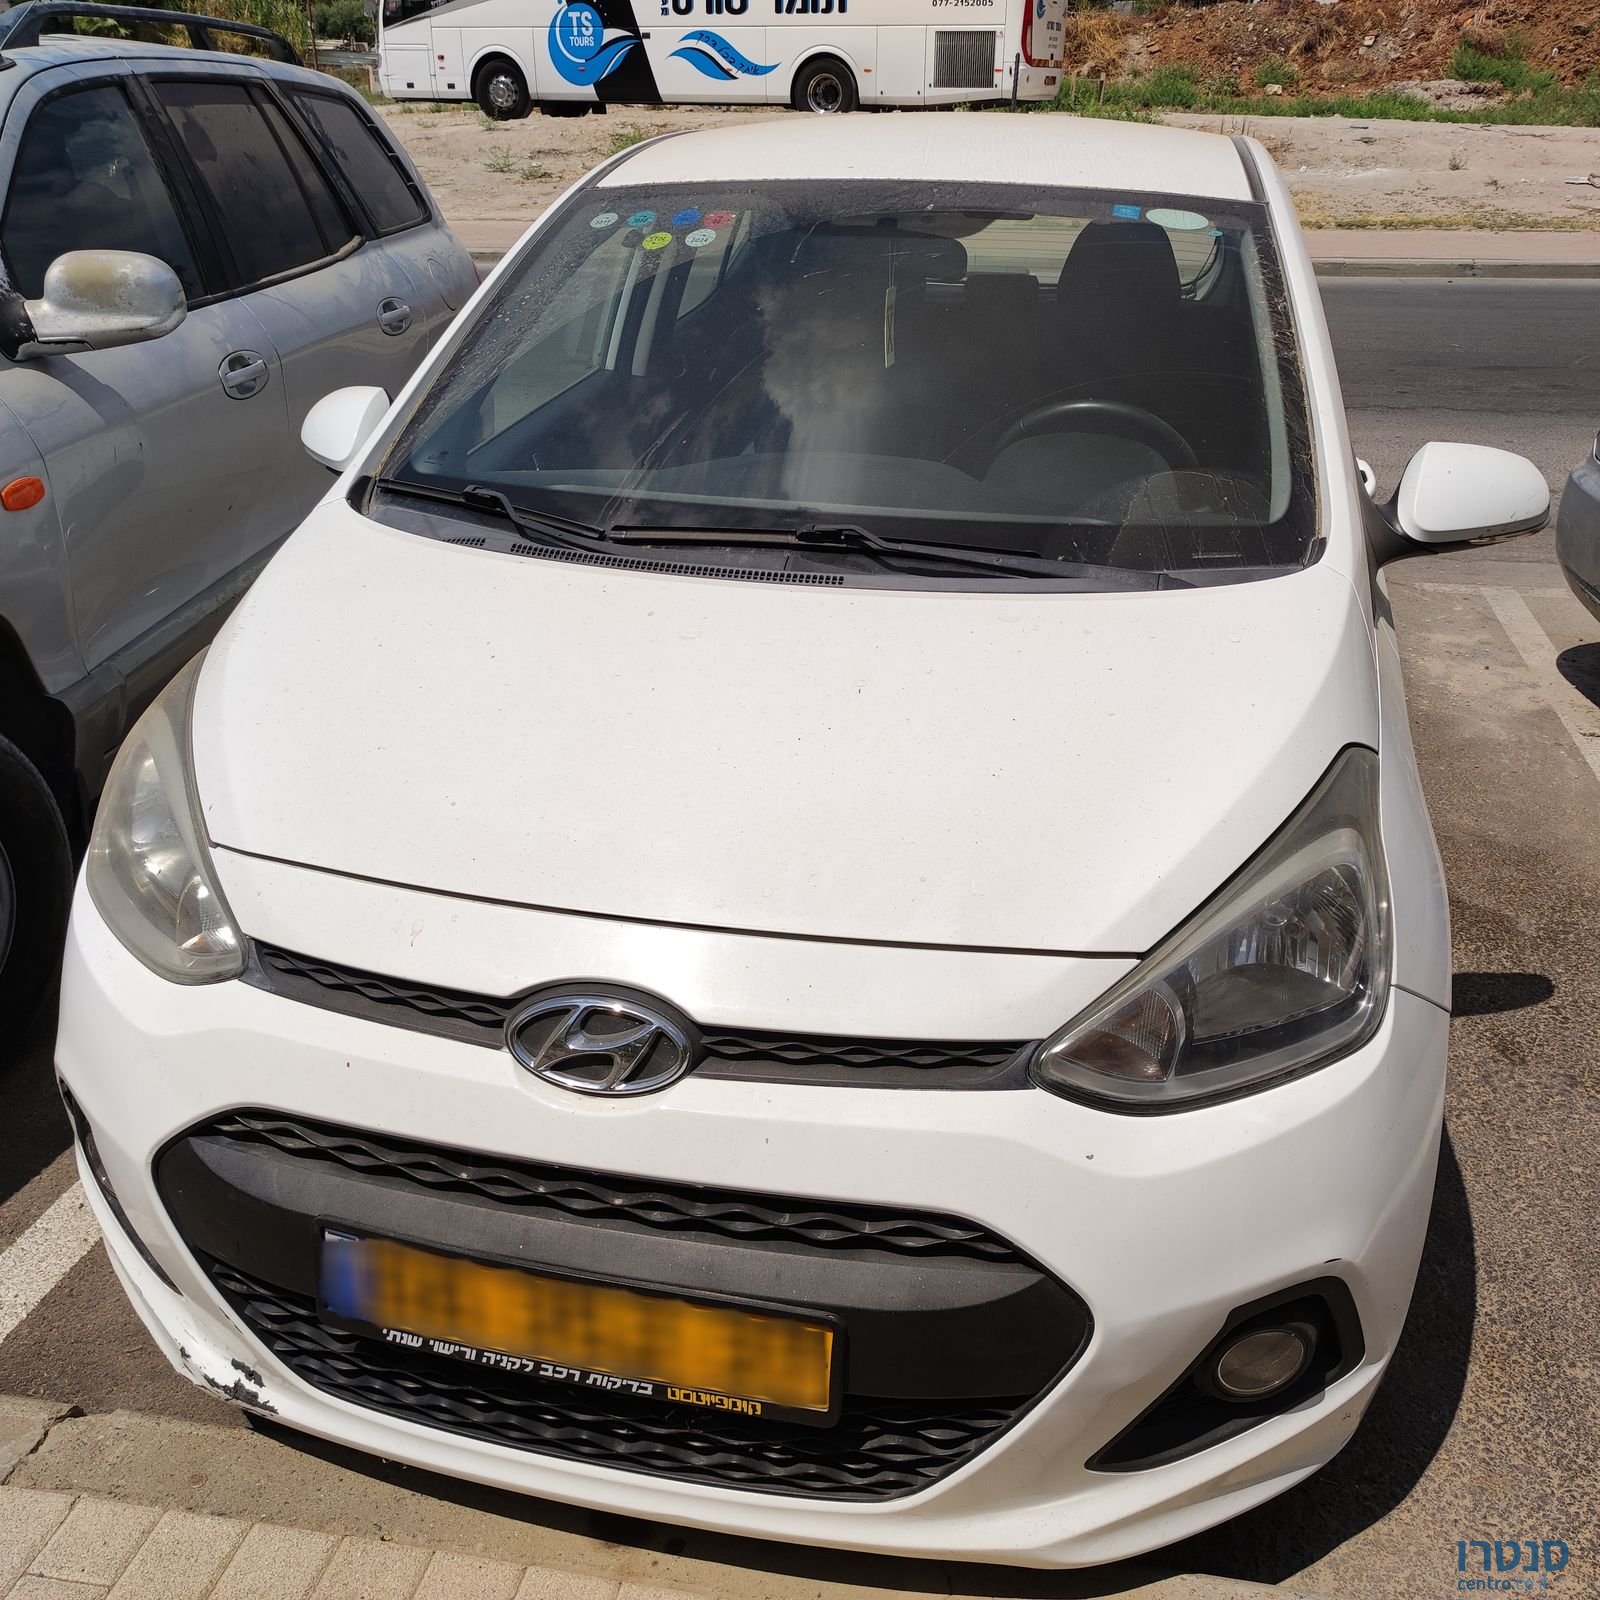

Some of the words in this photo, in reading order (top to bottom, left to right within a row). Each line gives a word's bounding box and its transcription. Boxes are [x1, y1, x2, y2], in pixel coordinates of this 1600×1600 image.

[568, 11, 593, 36] TS
[569, 37, 595, 46] TOURS
[382, 1328, 423, 1347] שנתי
[429, 1339, 476, 1360] ורישוי
[482, 1351, 534, 1371] לקניה
[540, 1363, 581, 1382] רכב
[586, 1374, 653, 1394] בדיקות
[668, 1387, 761, 1415] קומפיוטסט
